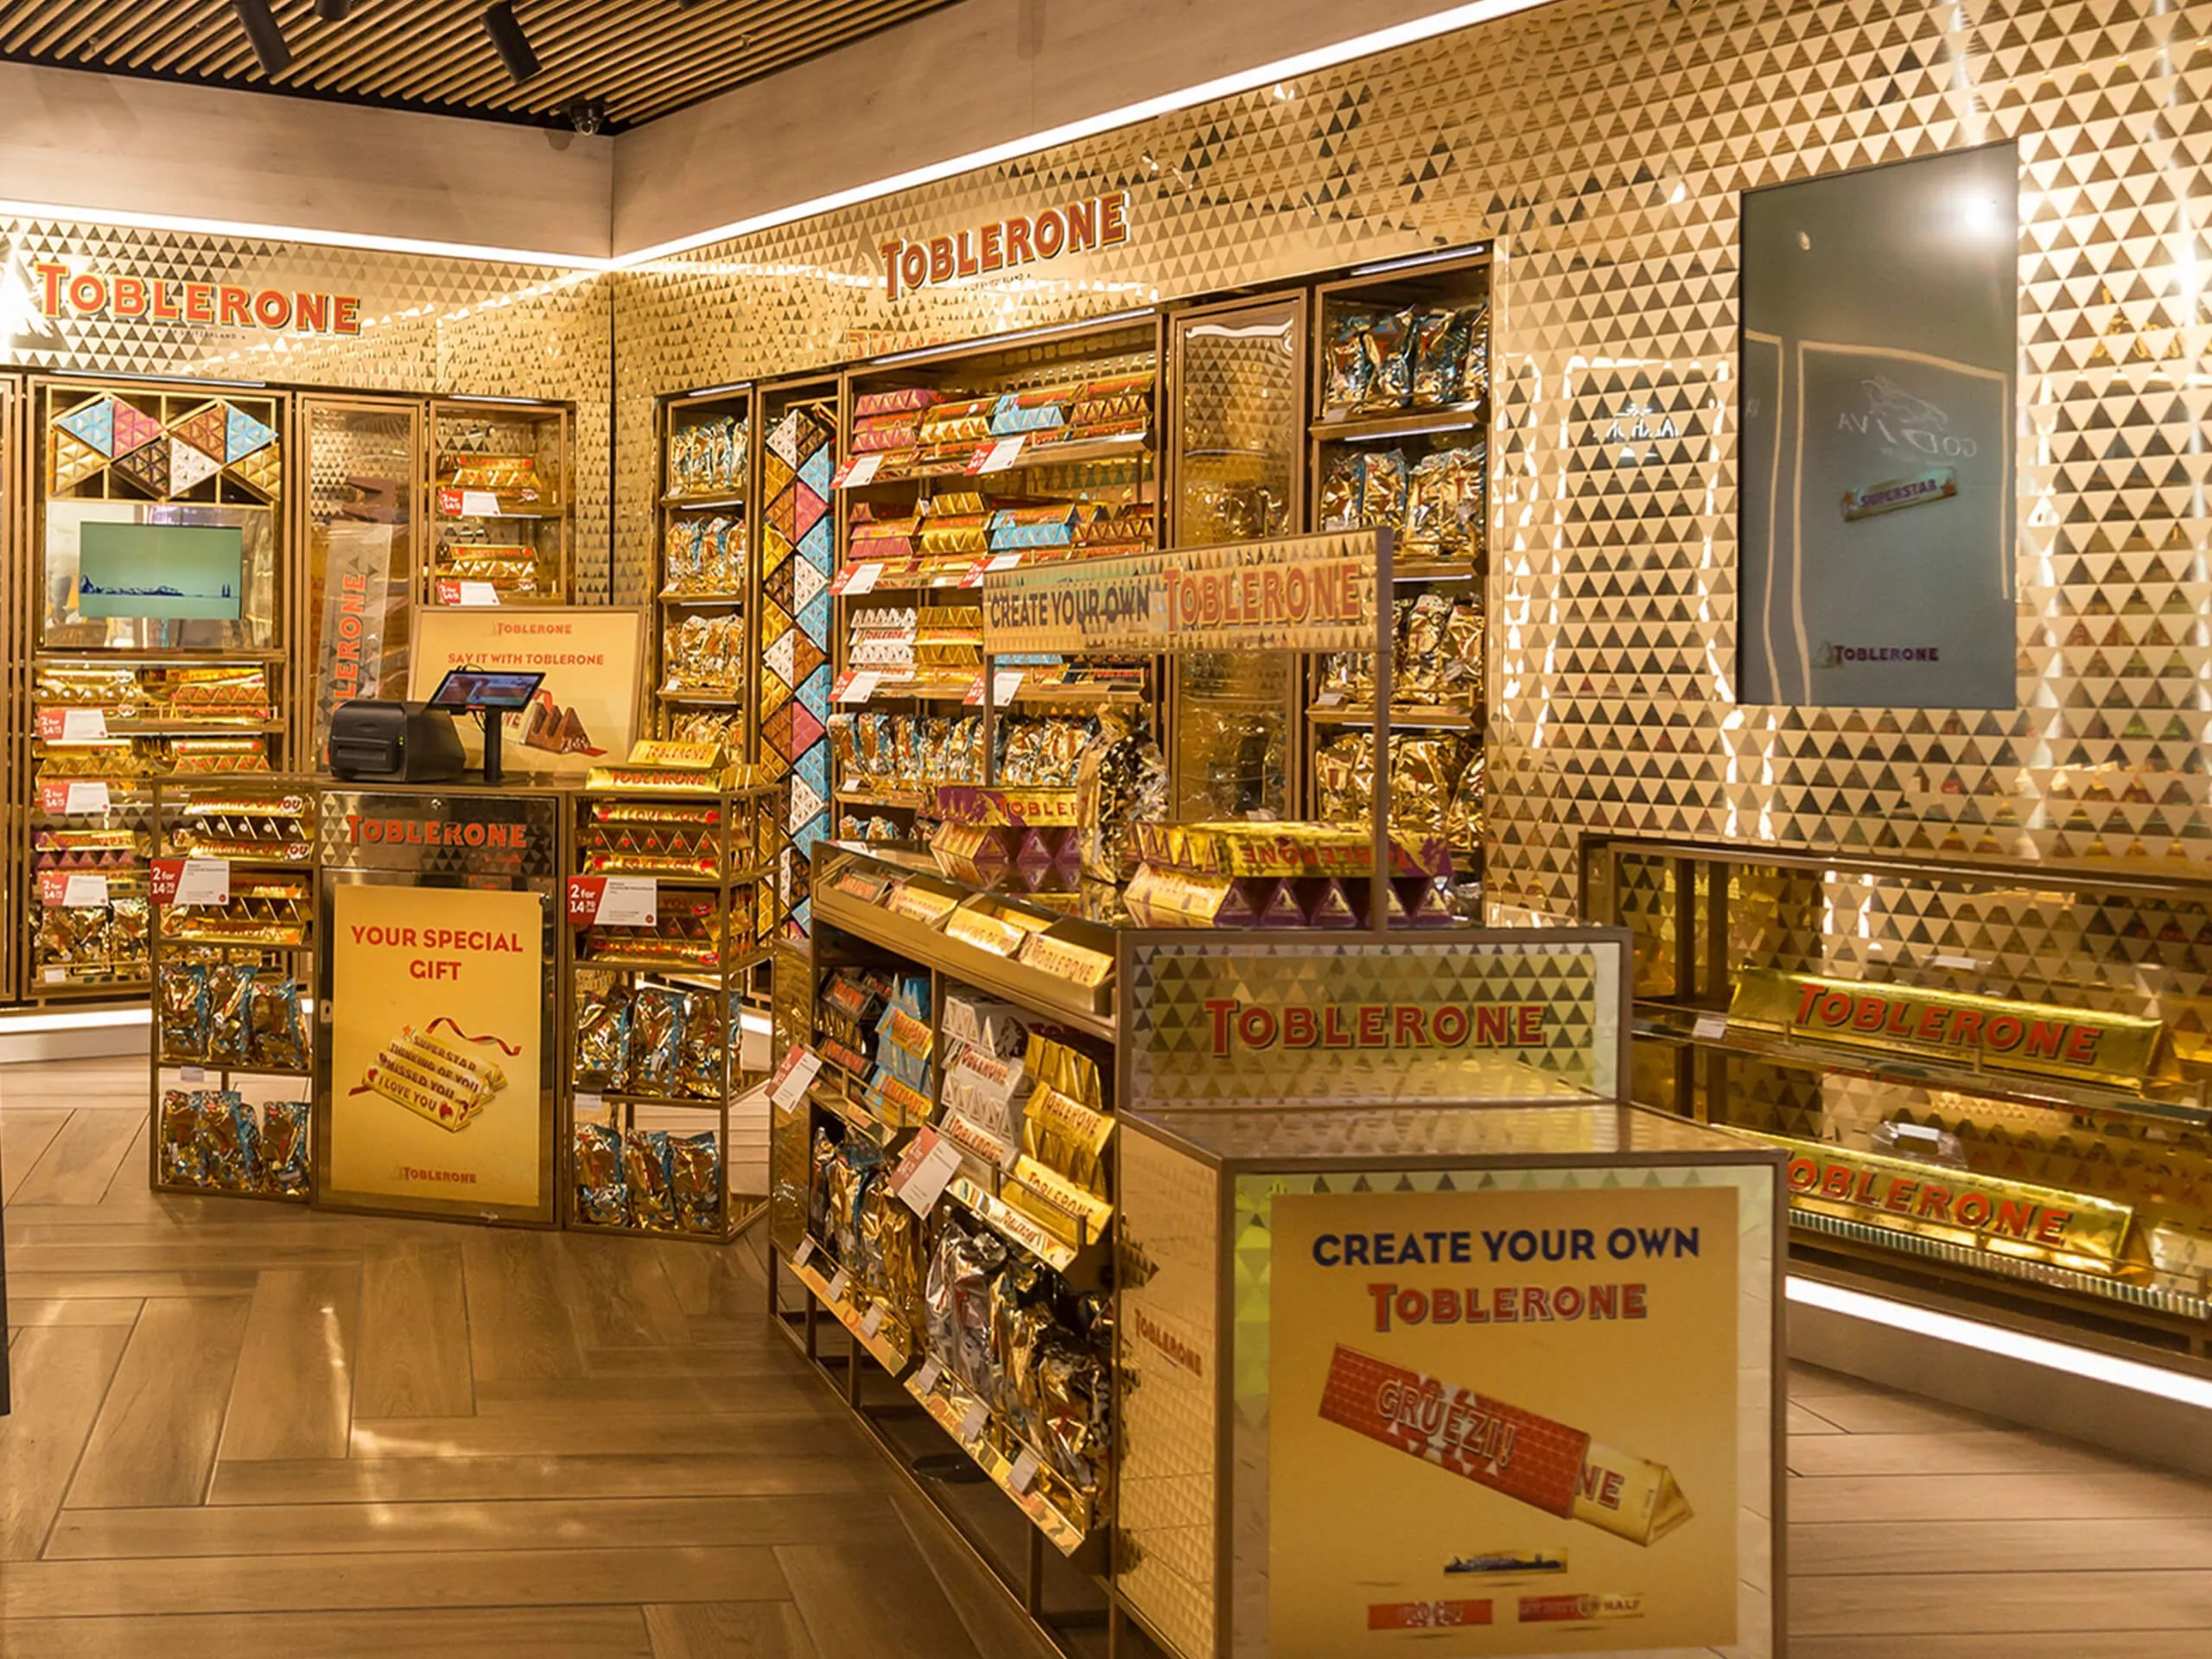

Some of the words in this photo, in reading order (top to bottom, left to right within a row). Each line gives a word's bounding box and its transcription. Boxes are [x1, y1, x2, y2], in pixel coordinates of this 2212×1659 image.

[880, 190, 1129, 302] TOBLERONE
[34, 261, 360, 334] TOBLERONE
[1859, 479, 1937, 508] SUPERSTAR
[989, 591, 1048, 628] CREATE
[1052, 589, 1099, 624] YOUR
[1105, 585, 1150, 622] OWN
[1163, 563, 1362, 632] TOBLERONE
[334, 574, 366, 700] LERONE
[497, 622, 572, 636] TOBLERONE
[448, 653, 474, 664] SAY
[475, 653, 489, 664] IT
[491, 653, 523, 664] WITH
[525, 654, 604, 665] TOBLERONE
[1834, 645, 1940, 664] TOBLERONE
[612, 771, 706, 785] TOBLERONE
[996, 797, 1078, 817] TOBLE
[346, 815, 527, 849] TOBLERONE
[1241, 843, 1410, 868] TBLERONE
[152, 867, 161, 881] 2
[162, 872, 175, 880] for
[570, 884, 580, 899] 2
[581, 888, 595, 899] for
[350, 925, 417, 948] YOUR
[423, 928, 524, 953] SPECIAL
[409, 959, 462, 981] GIFT
[1205, 998, 1548, 1058] TOBLERONE
[1794, 982, 2103, 1065] TOBLERONE
[413, 1034, 478, 1072] SUPERSTAR
[384, 1077, 410, 1097] LOVE
[412, 1091, 438, 1112] YOU
[429, 1083, 455, 1101] YOU
[454, 1073, 480, 1093] YOU
[403, 1166, 477, 1185] TOBLERONE
[1789, 1158, 2073, 1246] OBLERONE
[1313, 1230, 1472, 1268] CREATE
[1482, 1228, 1597, 1262] YOUR
[1606, 1226, 1700, 1259] OWN
[1368, 1282, 1647, 1332] TOBLERONE
[1134, 1307, 1203, 1378] TOBLERONE
